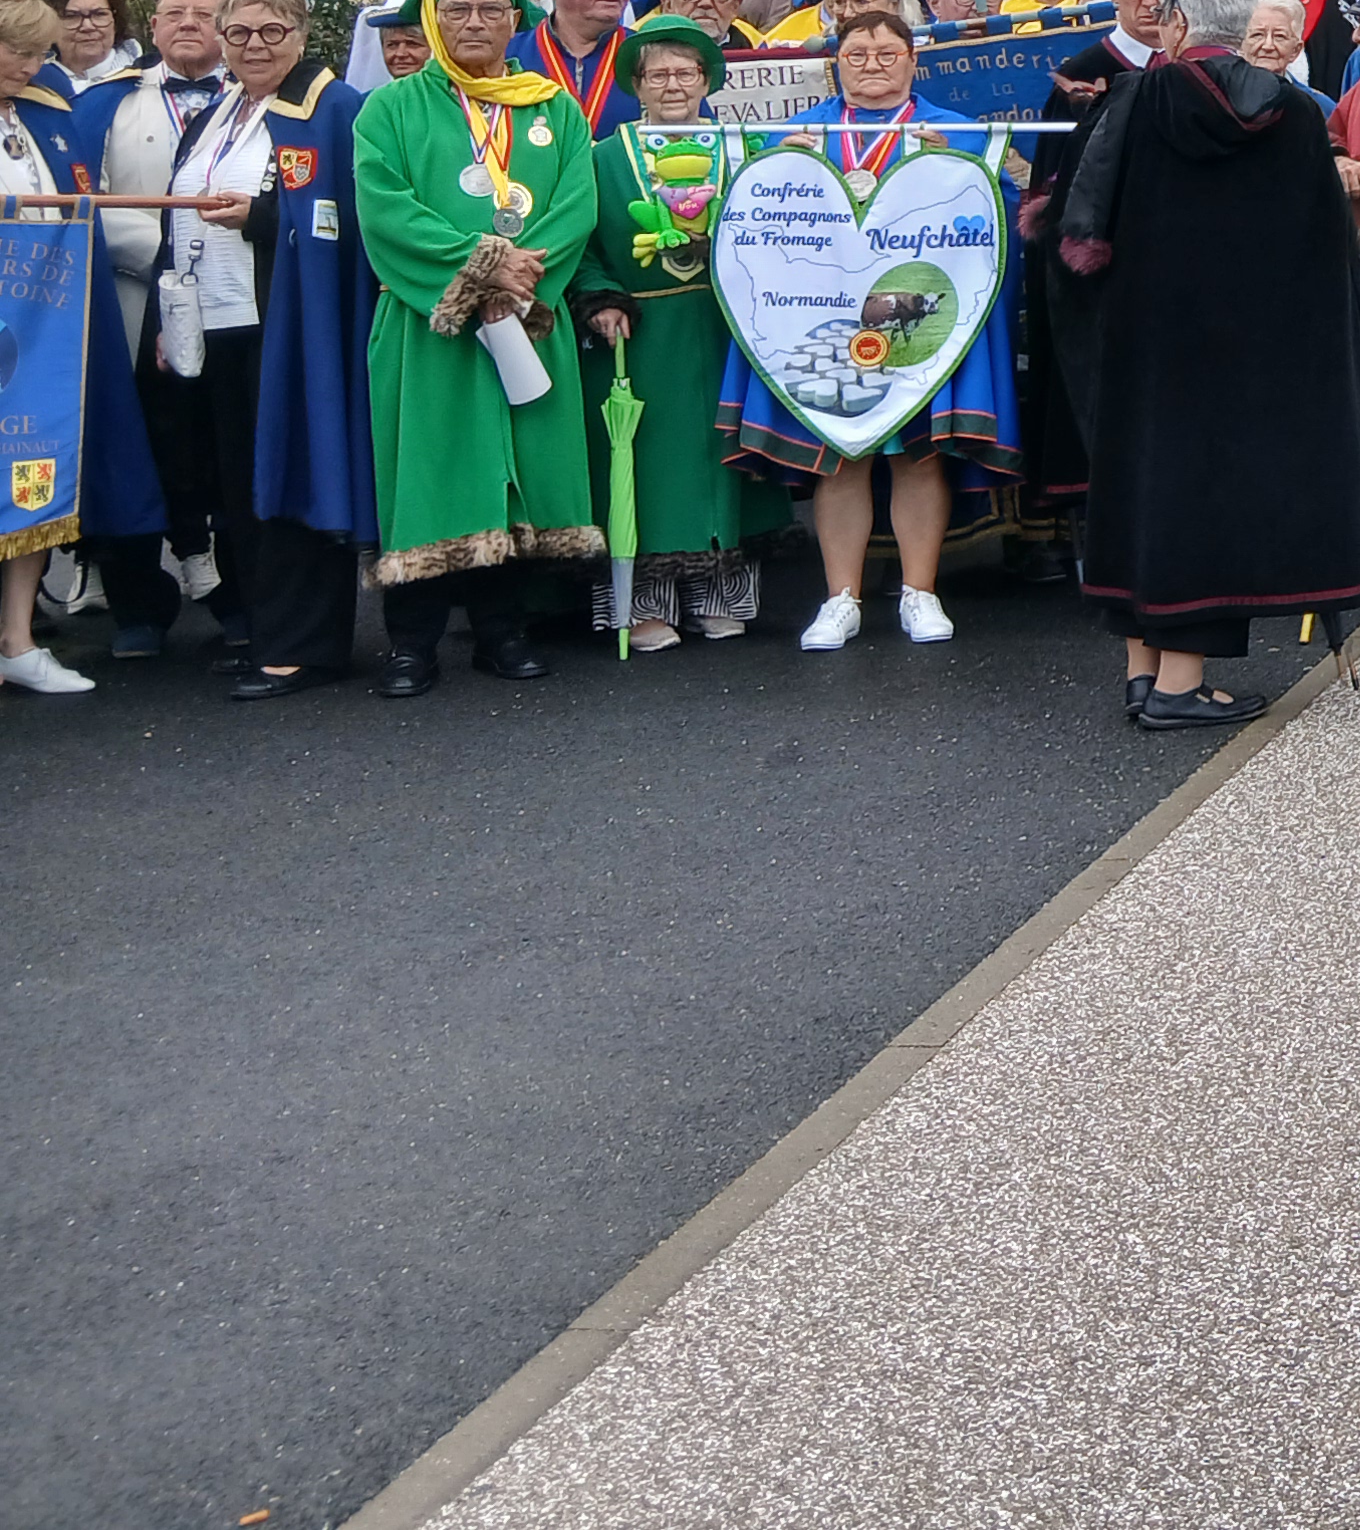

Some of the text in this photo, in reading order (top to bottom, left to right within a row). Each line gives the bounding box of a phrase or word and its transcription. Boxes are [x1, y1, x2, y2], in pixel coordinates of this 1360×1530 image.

[949, 87, 971, 102] de
[750, 182, 825, 203] Confrérie
[722, 207, 851, 227] des Compagnons
[734, 231, 833, 252] du Fromage
[866, 224, 995, 258] Neufchâtel
[31, 242, 76, 266] DES
[42, 264, 74, 286] DE
[762, 291, 858, 309] Normandie
